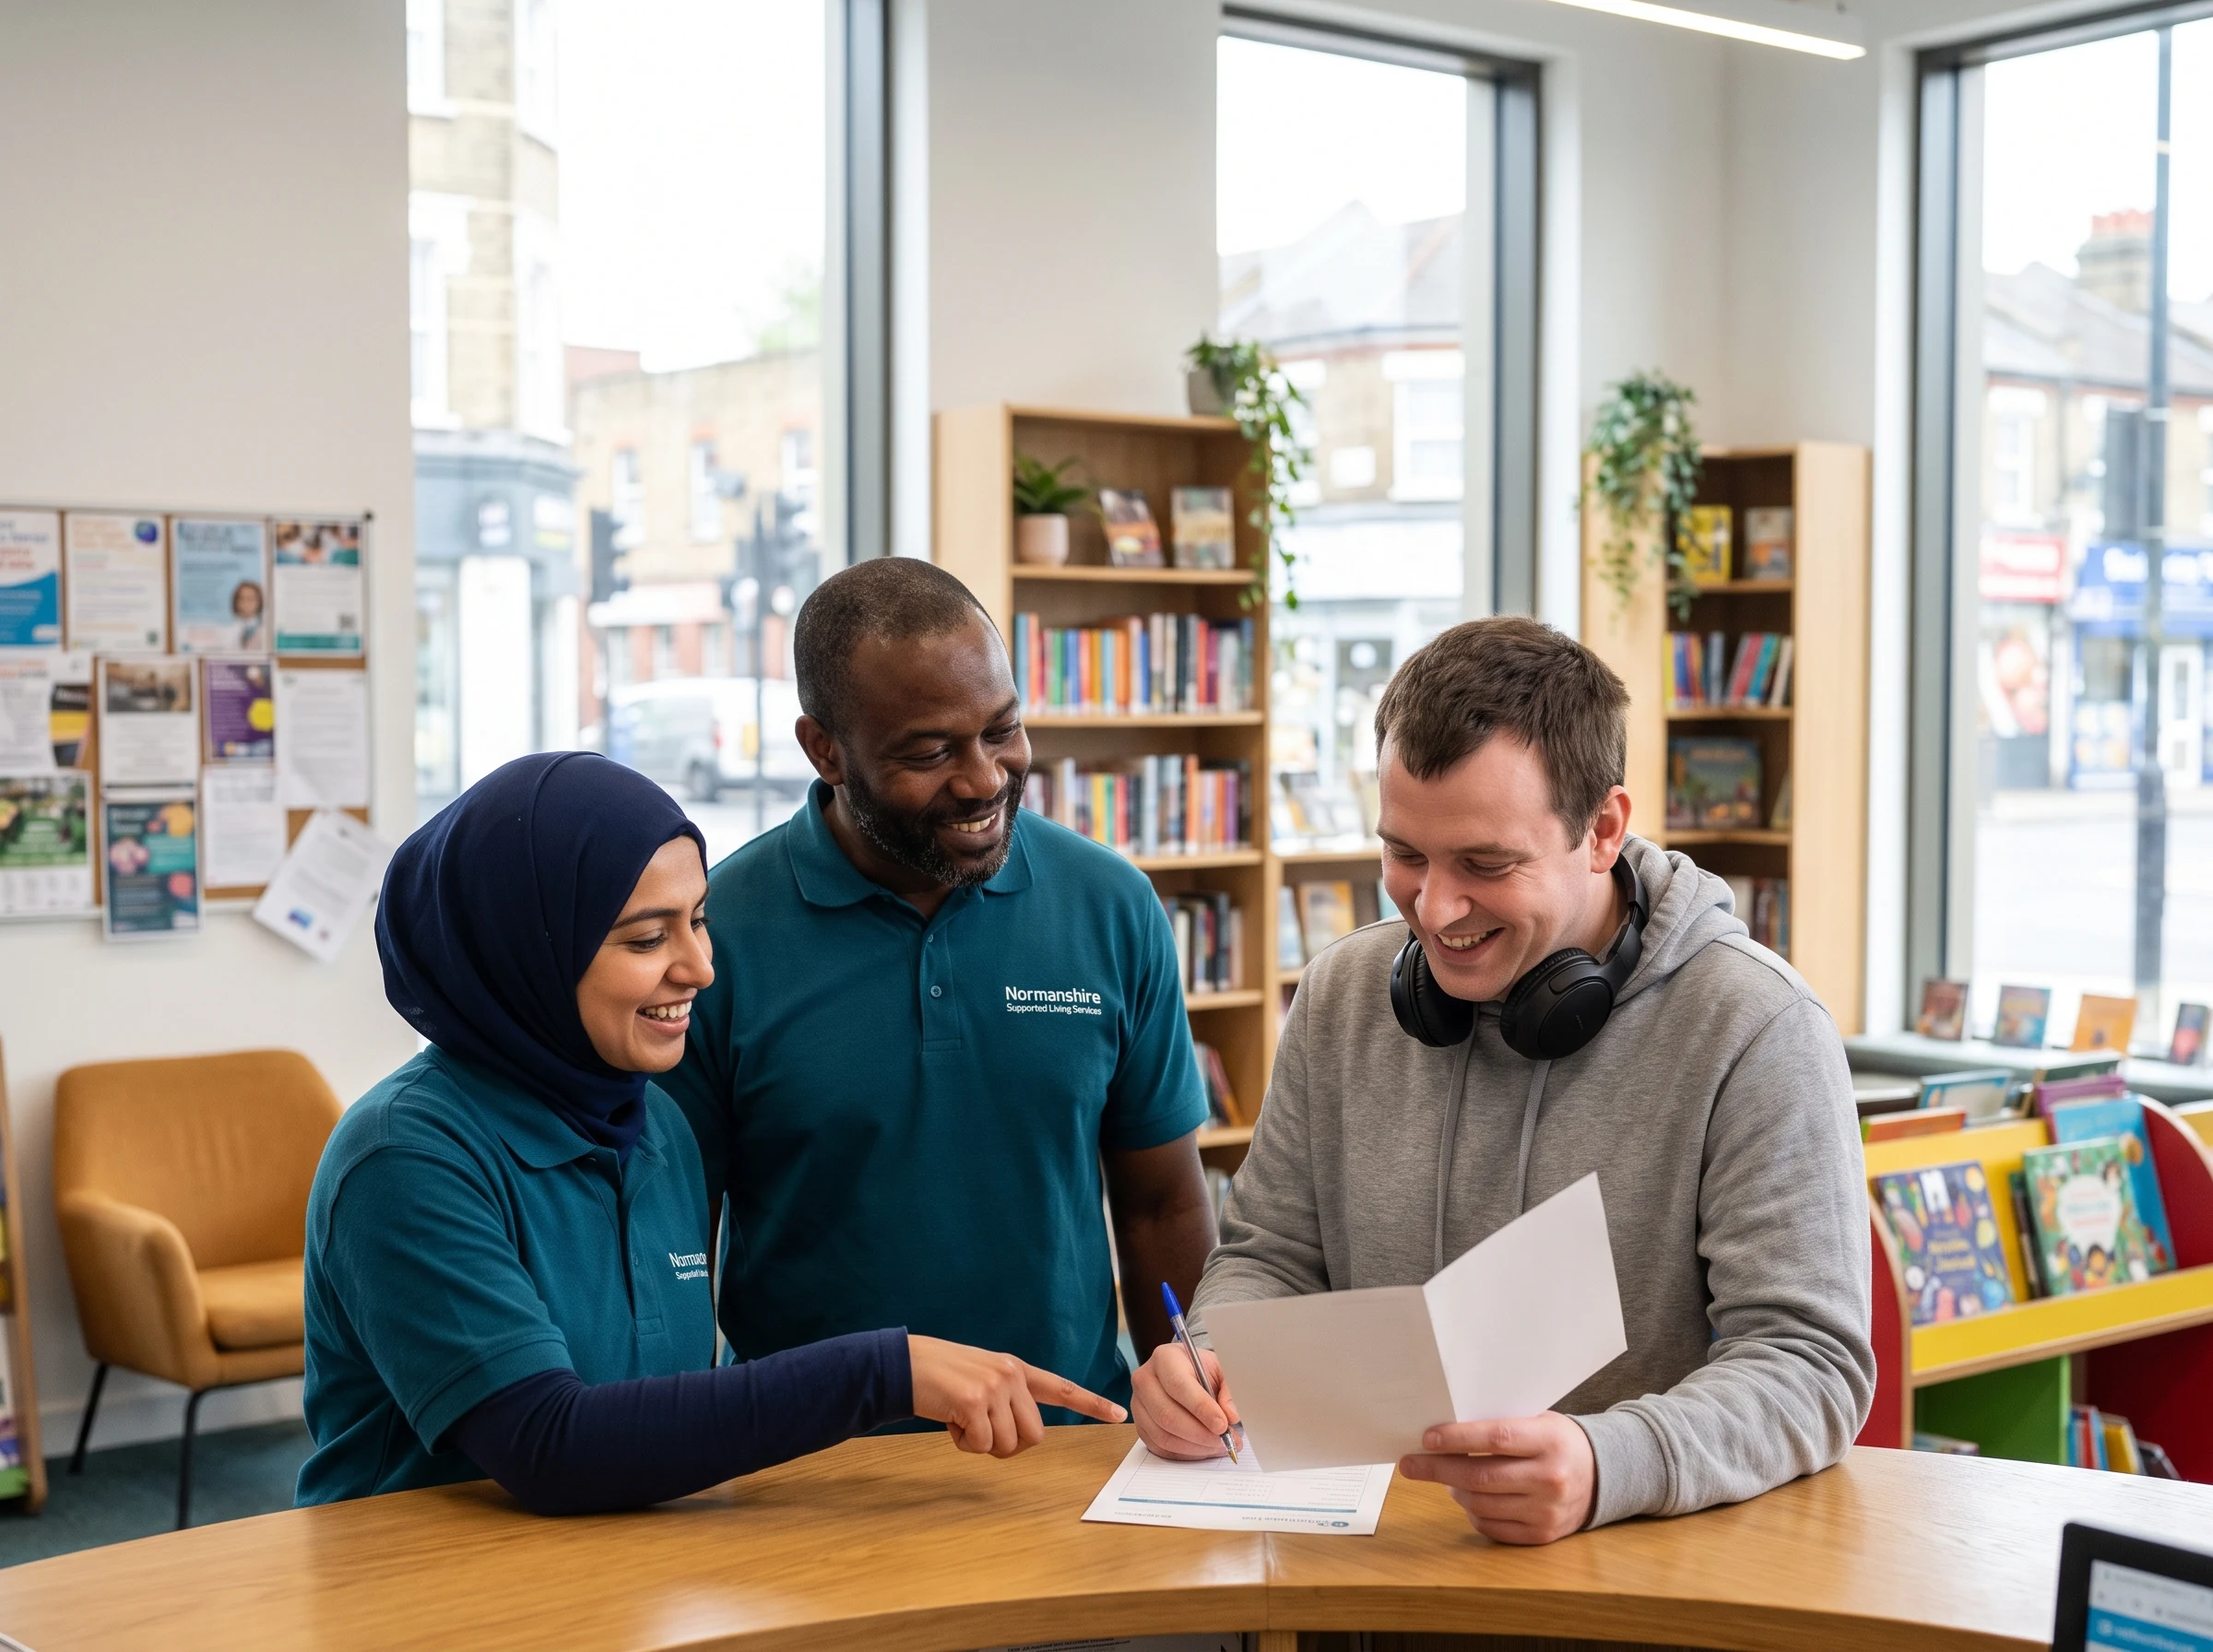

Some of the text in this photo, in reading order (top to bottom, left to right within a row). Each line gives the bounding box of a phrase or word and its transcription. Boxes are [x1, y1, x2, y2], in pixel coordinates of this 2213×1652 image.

[1005, 985, 1101, 1004] Normanshire
[1006, 1003, 1102, 1016] Supported Living Services
